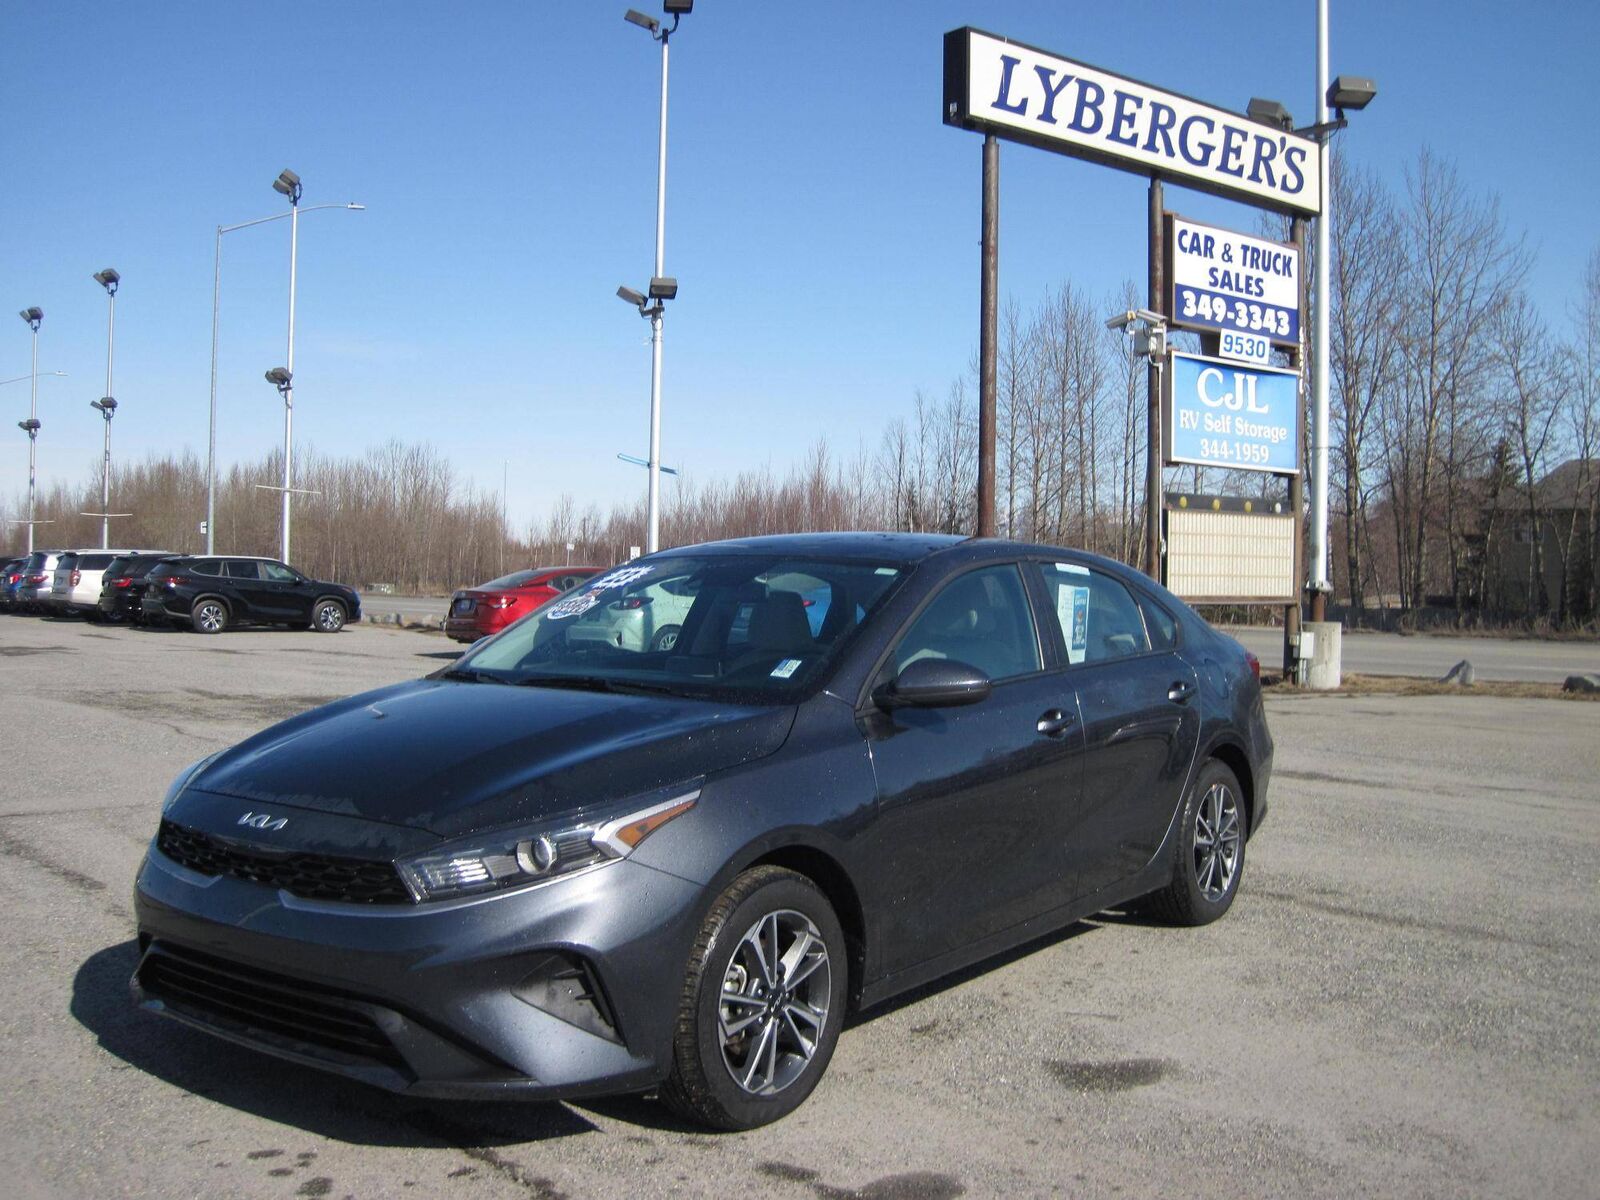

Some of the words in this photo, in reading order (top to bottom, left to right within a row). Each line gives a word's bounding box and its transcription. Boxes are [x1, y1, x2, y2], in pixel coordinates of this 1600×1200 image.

[991, 54, 1306, 195] LYBERGER'S
[1177, 228, 1215, 259] CAR
[1221, 242, 1233, 263] &
[1240, 244, 1293, 278] TRUCK
[1208, 266, 1265, 298] SALES
[1182, 290, 1291, 336] 349-3343
[1223, 334, 1266, 358] 9530
[1197, 367, 1269, 414] CJL
[1179, 409, 1200, 431] RV
[1204, 412, 1232, 433] Self
[1235, 416, 1288, 443] Storage
[1200, 438, 1270, 464] 344-1959
